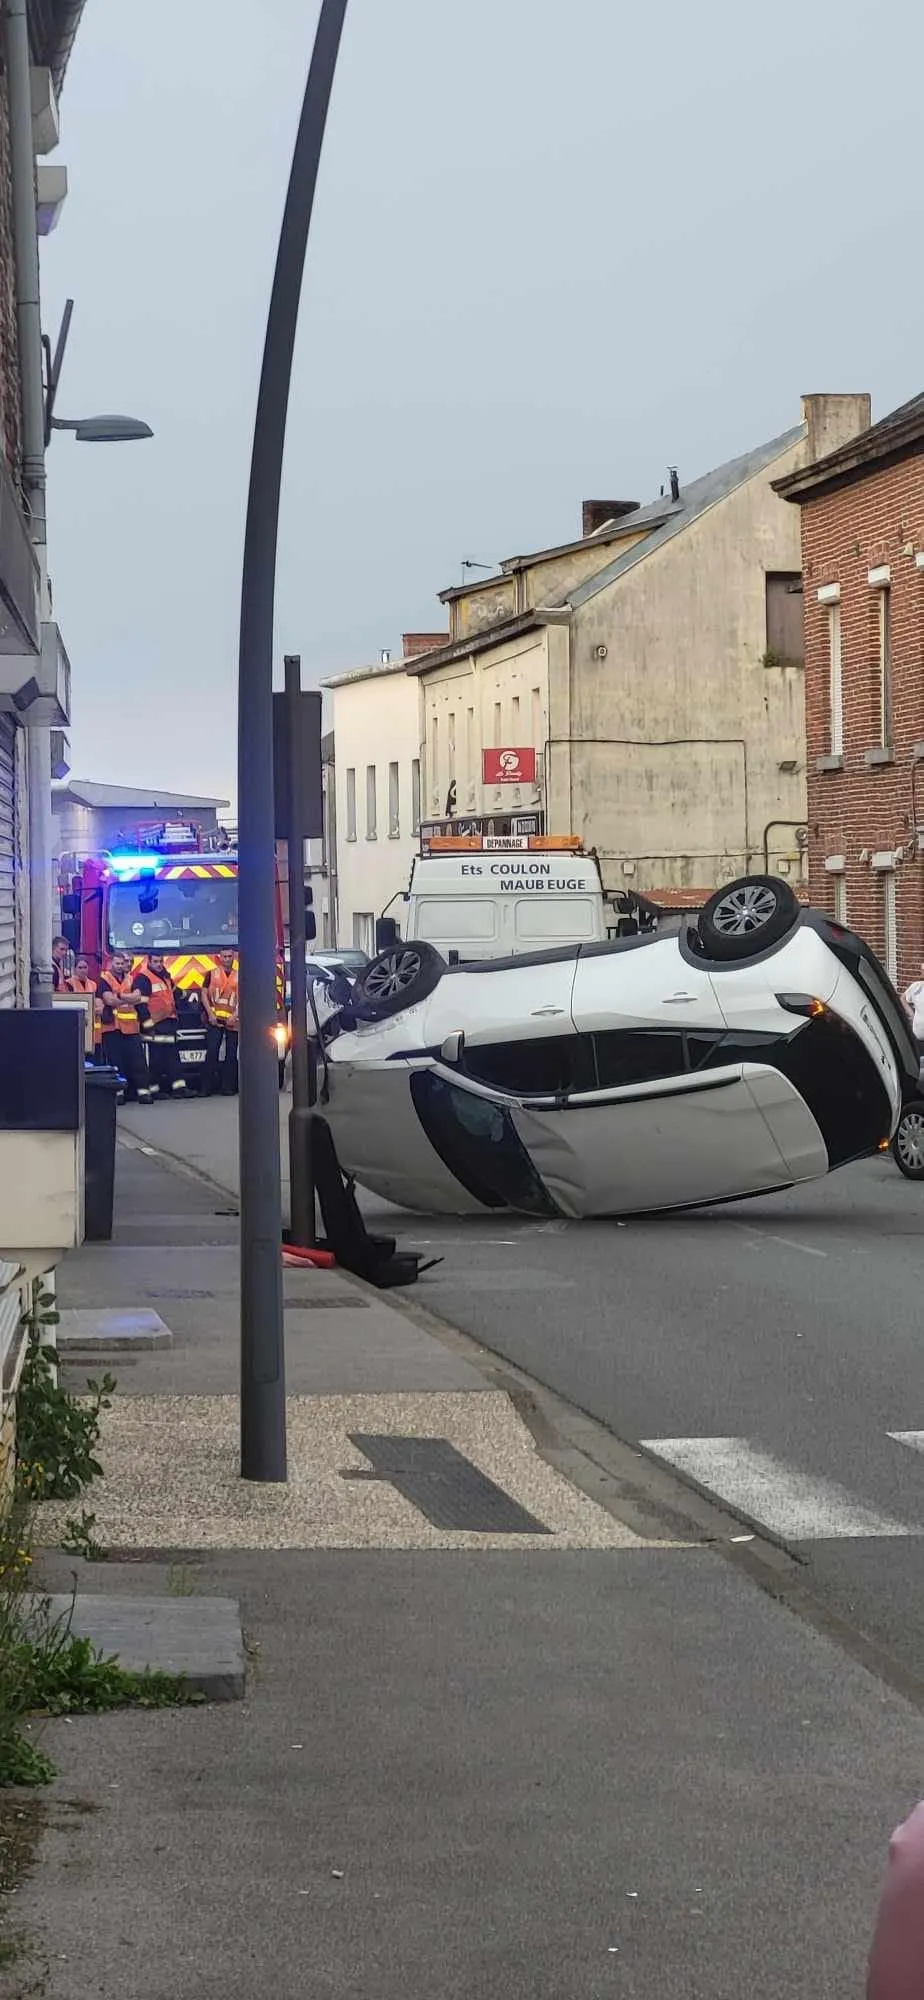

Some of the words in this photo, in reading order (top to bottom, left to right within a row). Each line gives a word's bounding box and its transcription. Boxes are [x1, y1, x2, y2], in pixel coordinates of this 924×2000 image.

[461, 864, 483, 875] Ets
[490, 864, 550, 875] COULON
[500, 879, 586, 891] MAUBEUGE
